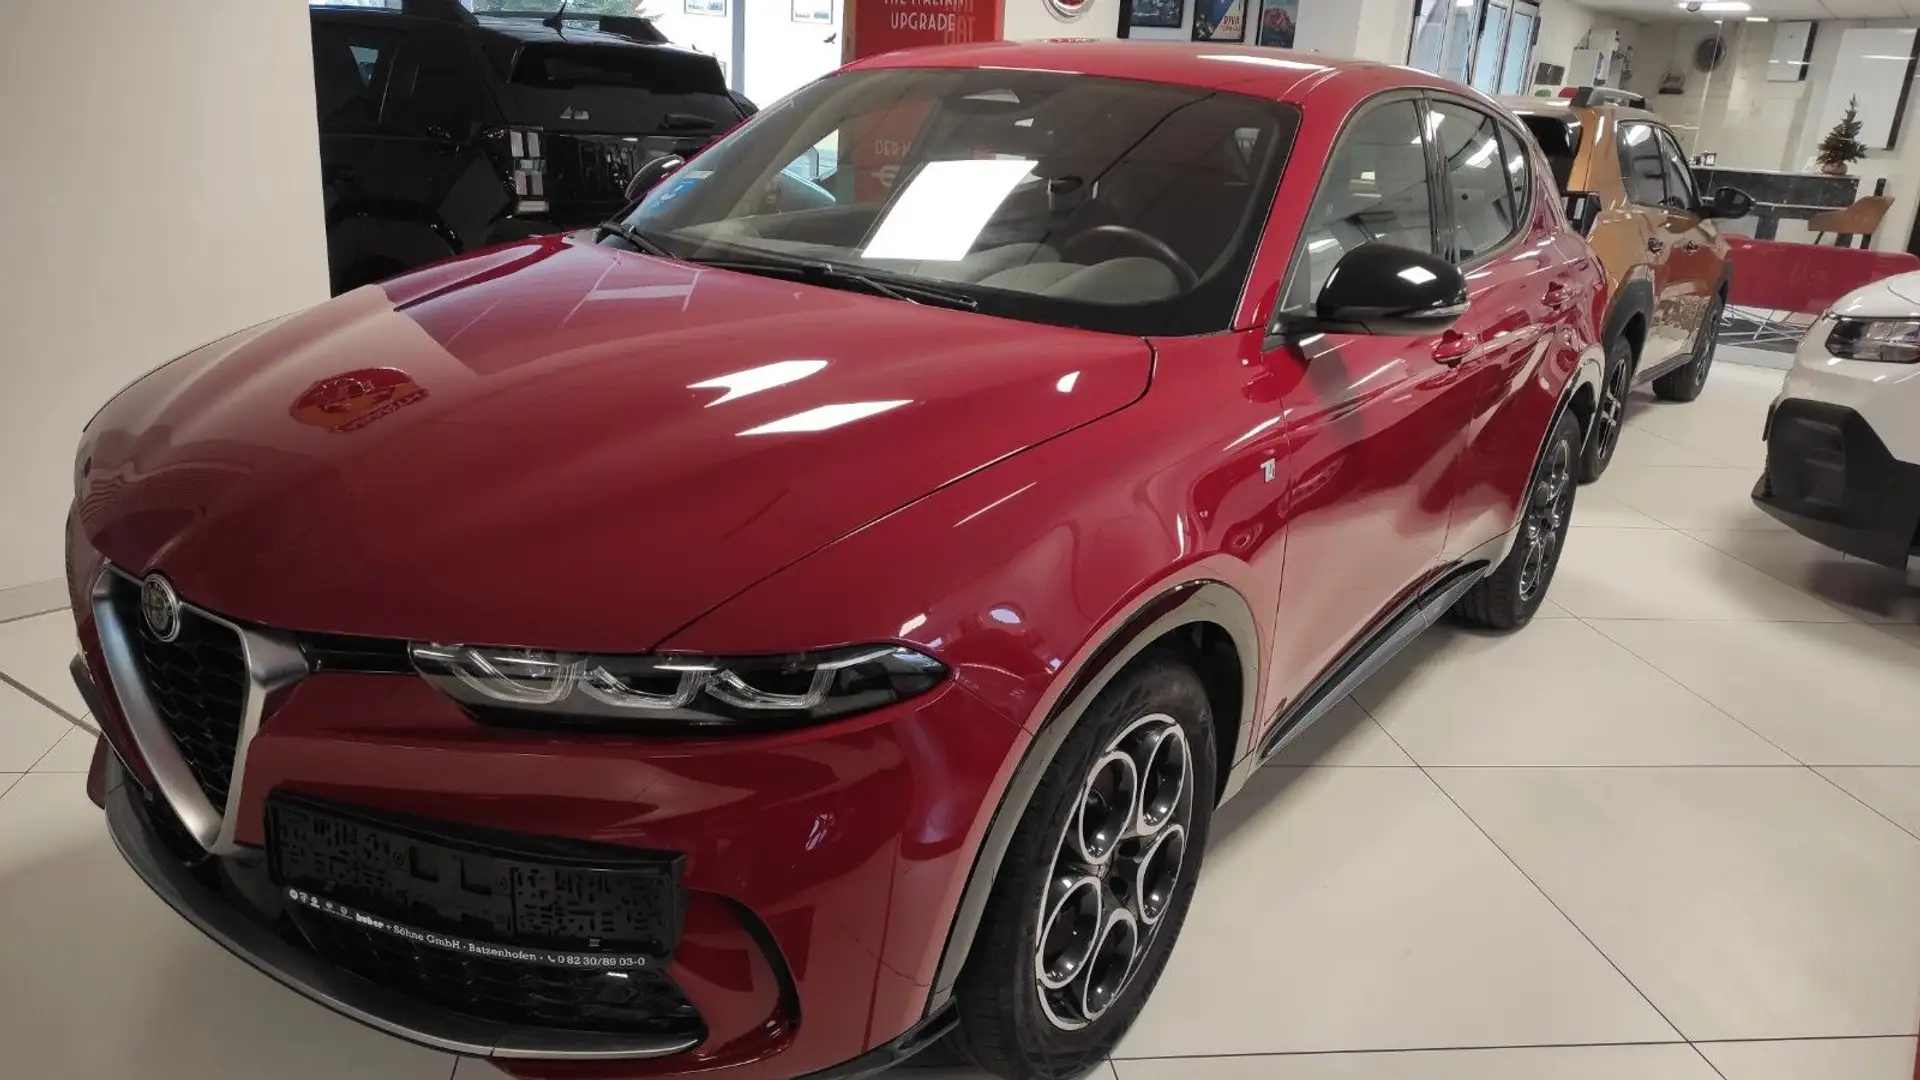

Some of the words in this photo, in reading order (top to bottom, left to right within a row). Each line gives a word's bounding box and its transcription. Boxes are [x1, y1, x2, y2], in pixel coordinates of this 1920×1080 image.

[891, 12, 956, 31] UPGRADE
[393, 925, 424, 941] Söhne
[426, 934, 461, 949] GmbH
[468, 943, 537, 961] Batzenhofen
